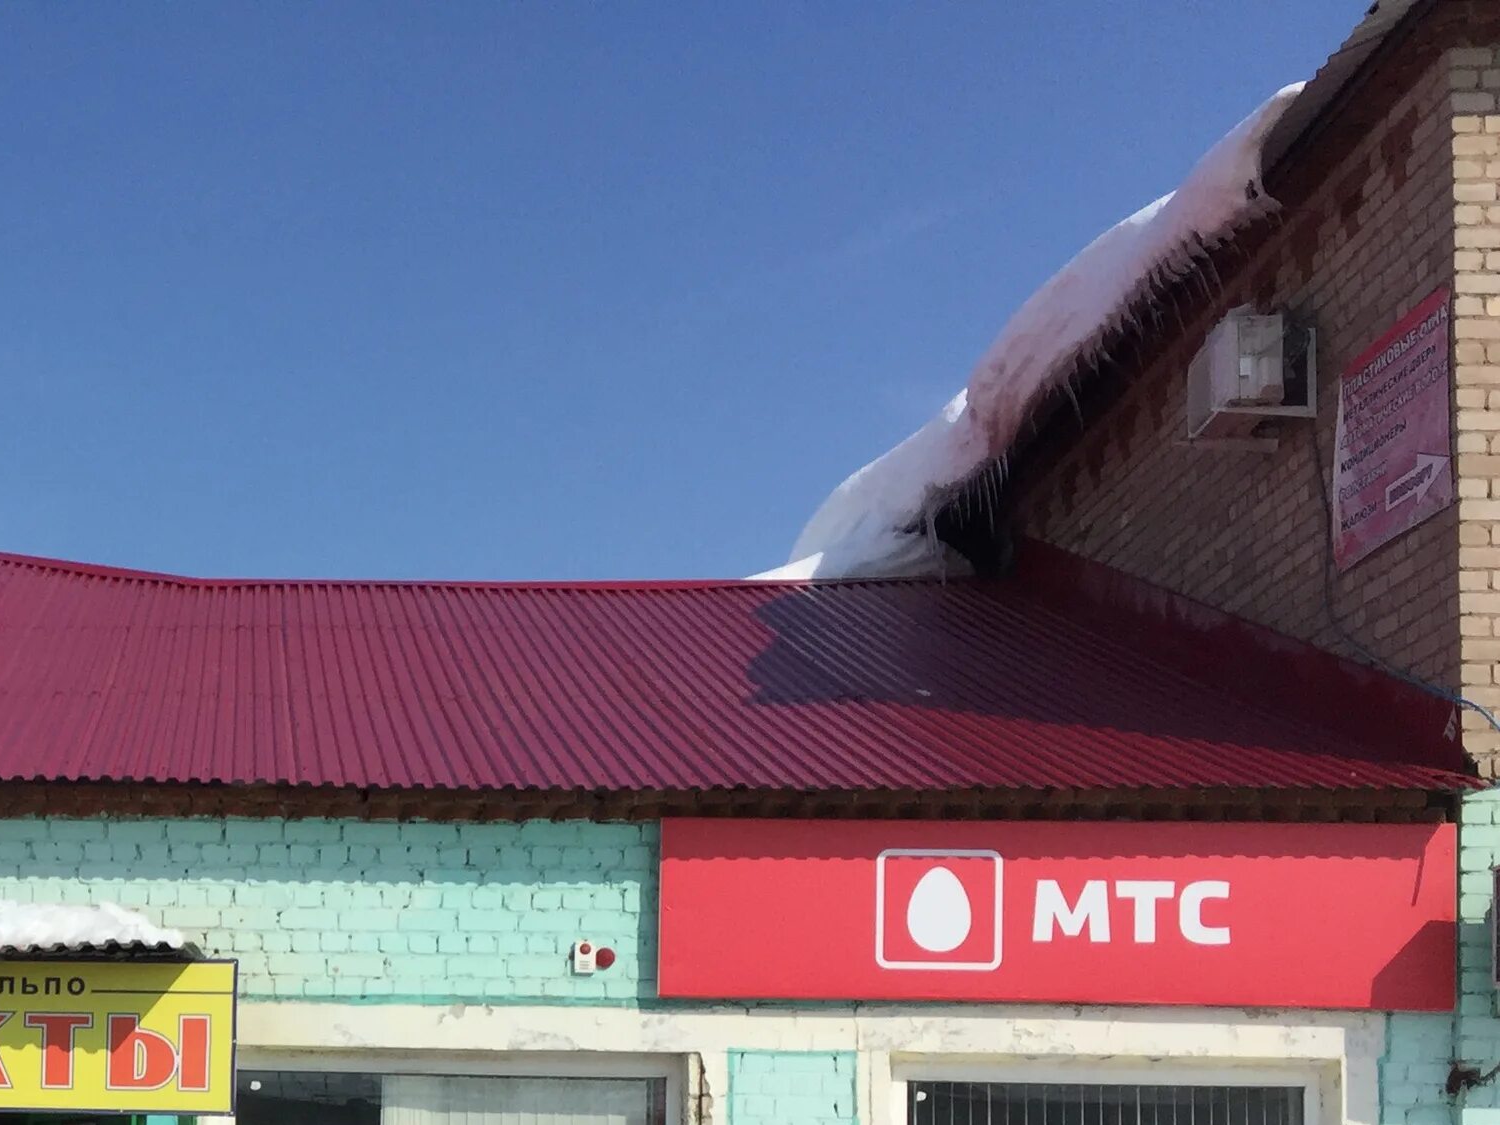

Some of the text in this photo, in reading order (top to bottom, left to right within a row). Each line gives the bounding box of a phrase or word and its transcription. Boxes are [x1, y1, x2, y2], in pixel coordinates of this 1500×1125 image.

[1342, 329, 1418, 400] ПЛАСТИКОВЫЕ
[1340, 500, 1378, 533] ЖАЛЮЗИ
[1032, 879, 1231, 945] МТС
